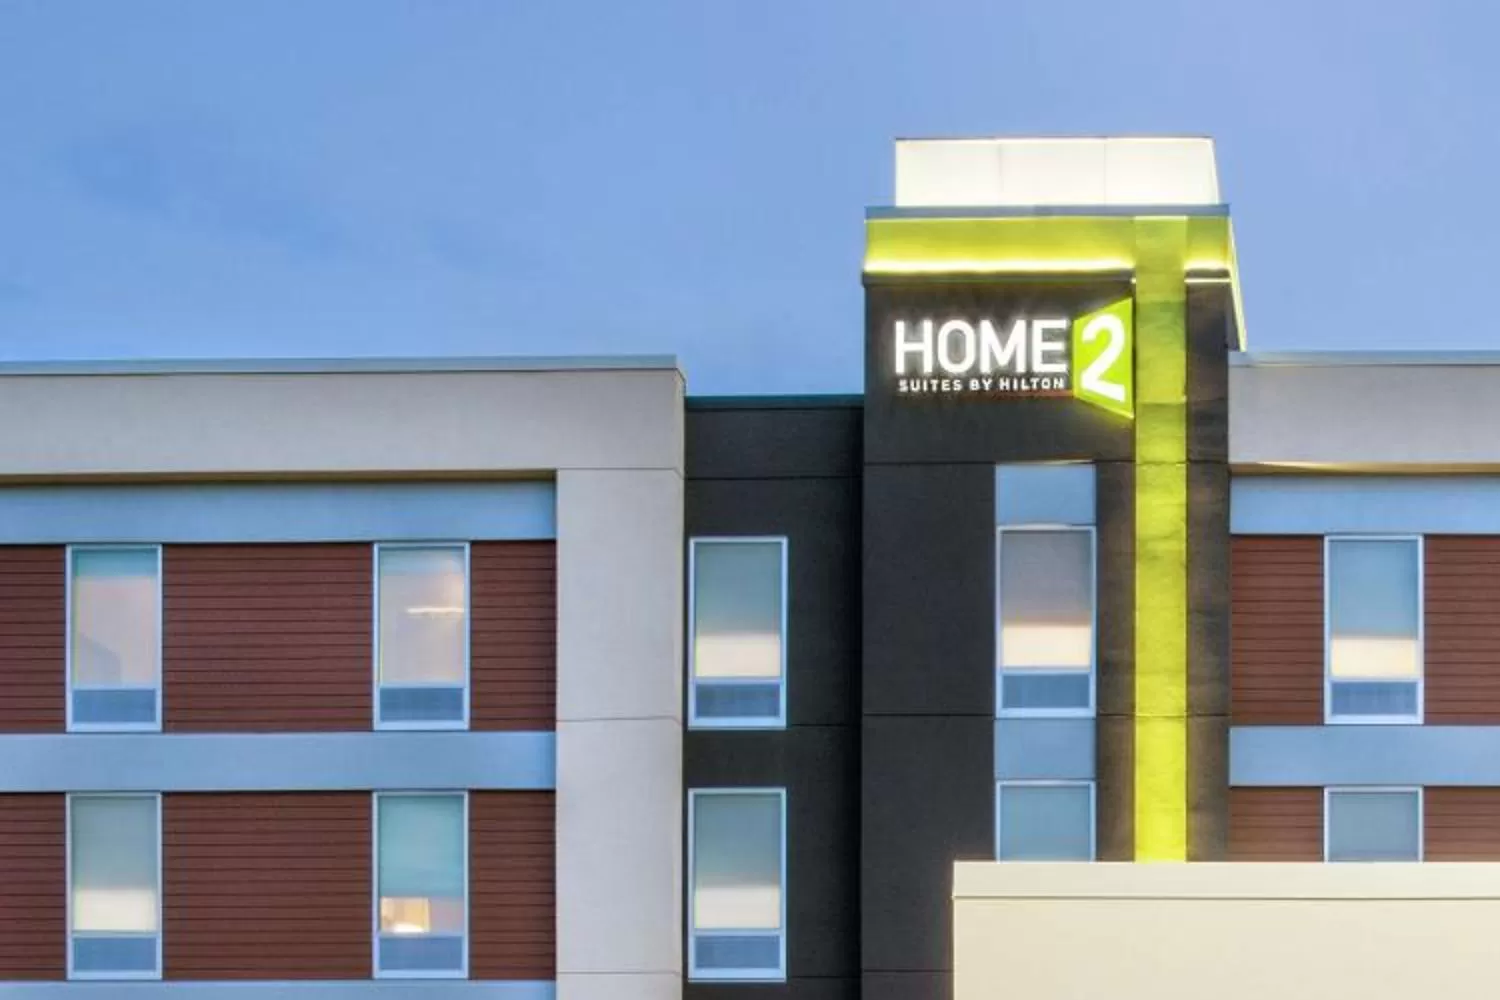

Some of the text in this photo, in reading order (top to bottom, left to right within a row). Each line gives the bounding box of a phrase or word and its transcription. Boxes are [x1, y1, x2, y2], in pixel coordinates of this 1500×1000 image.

[899, 377, 1065, 392] SUITES BY HILTON
